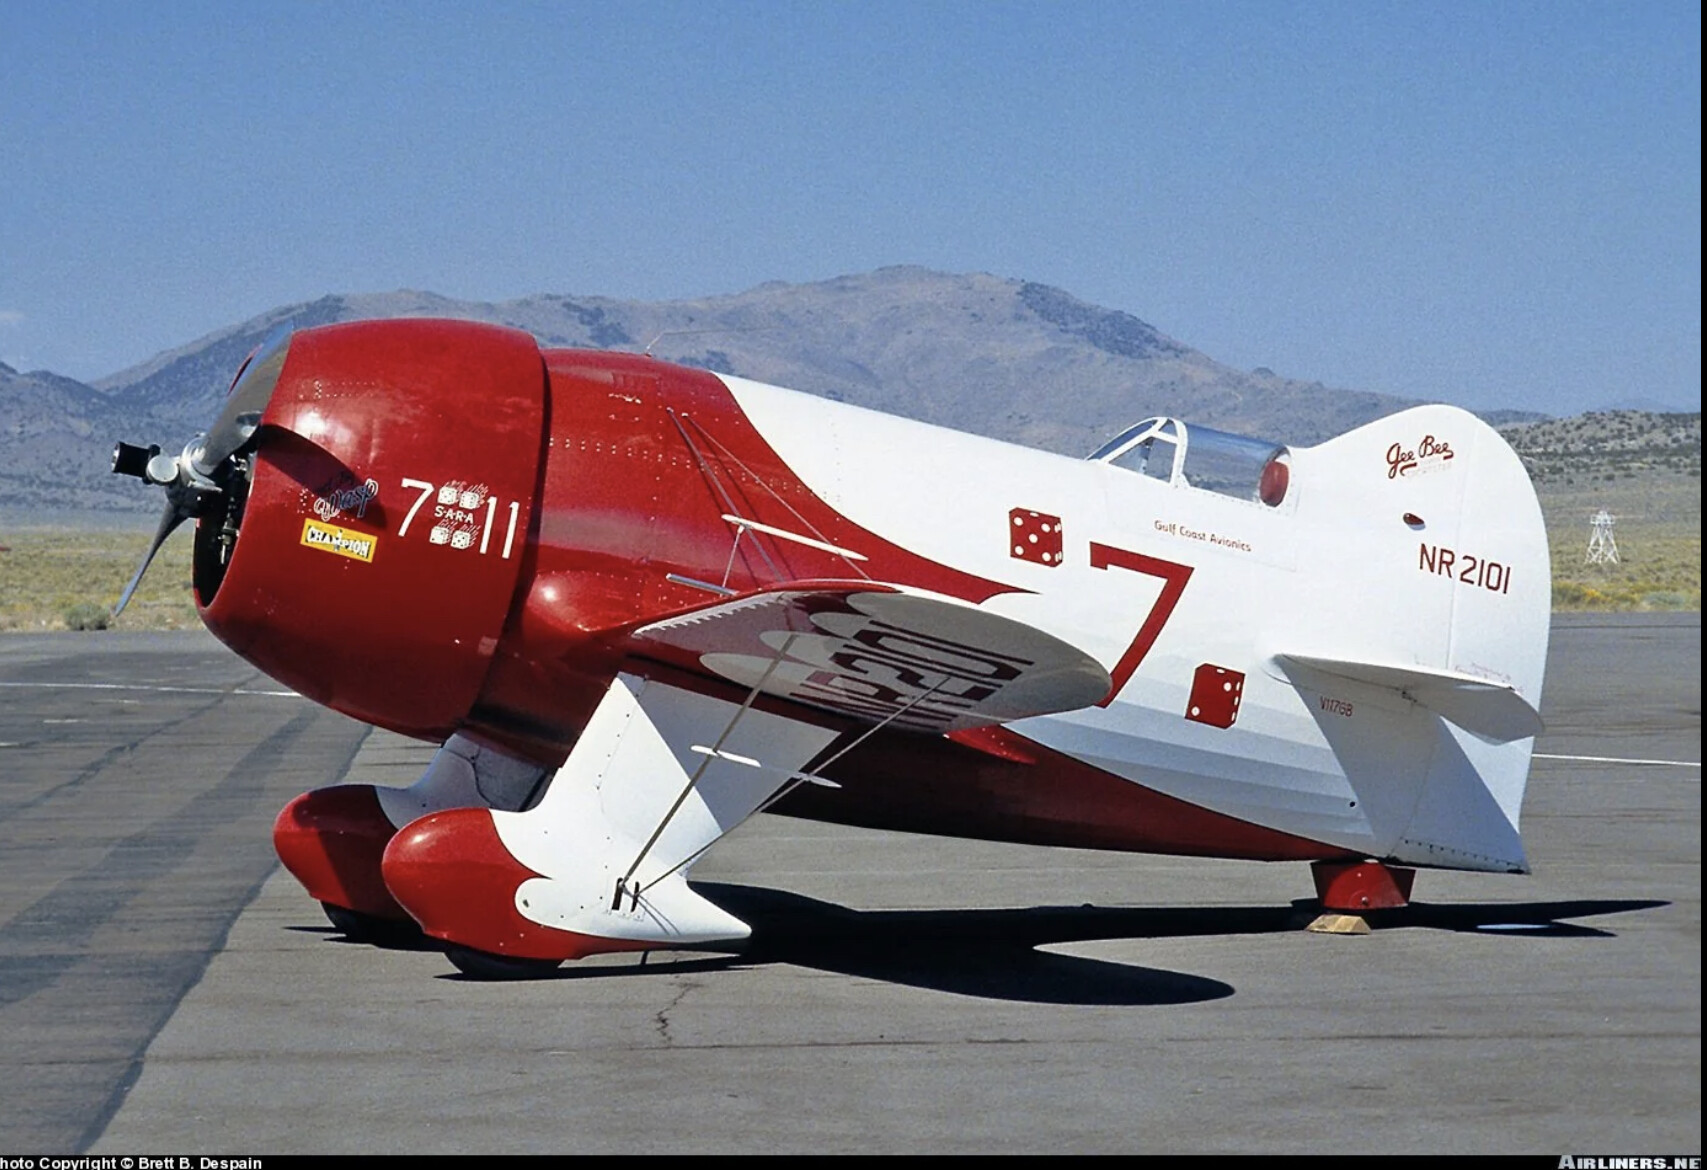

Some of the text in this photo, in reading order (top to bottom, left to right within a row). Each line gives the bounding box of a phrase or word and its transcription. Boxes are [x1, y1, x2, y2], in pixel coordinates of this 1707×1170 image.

[1386, 443, 1417, 479] Gee
[1419, 435, 1454, 460] Bee
[398, 477, 435, 537] 7
[306, 525, 371, 558] CHAMPION
[1154, 519, 1252, 552] Gulf Coast Avionics
[1090, 541, 1195, 708] 7
